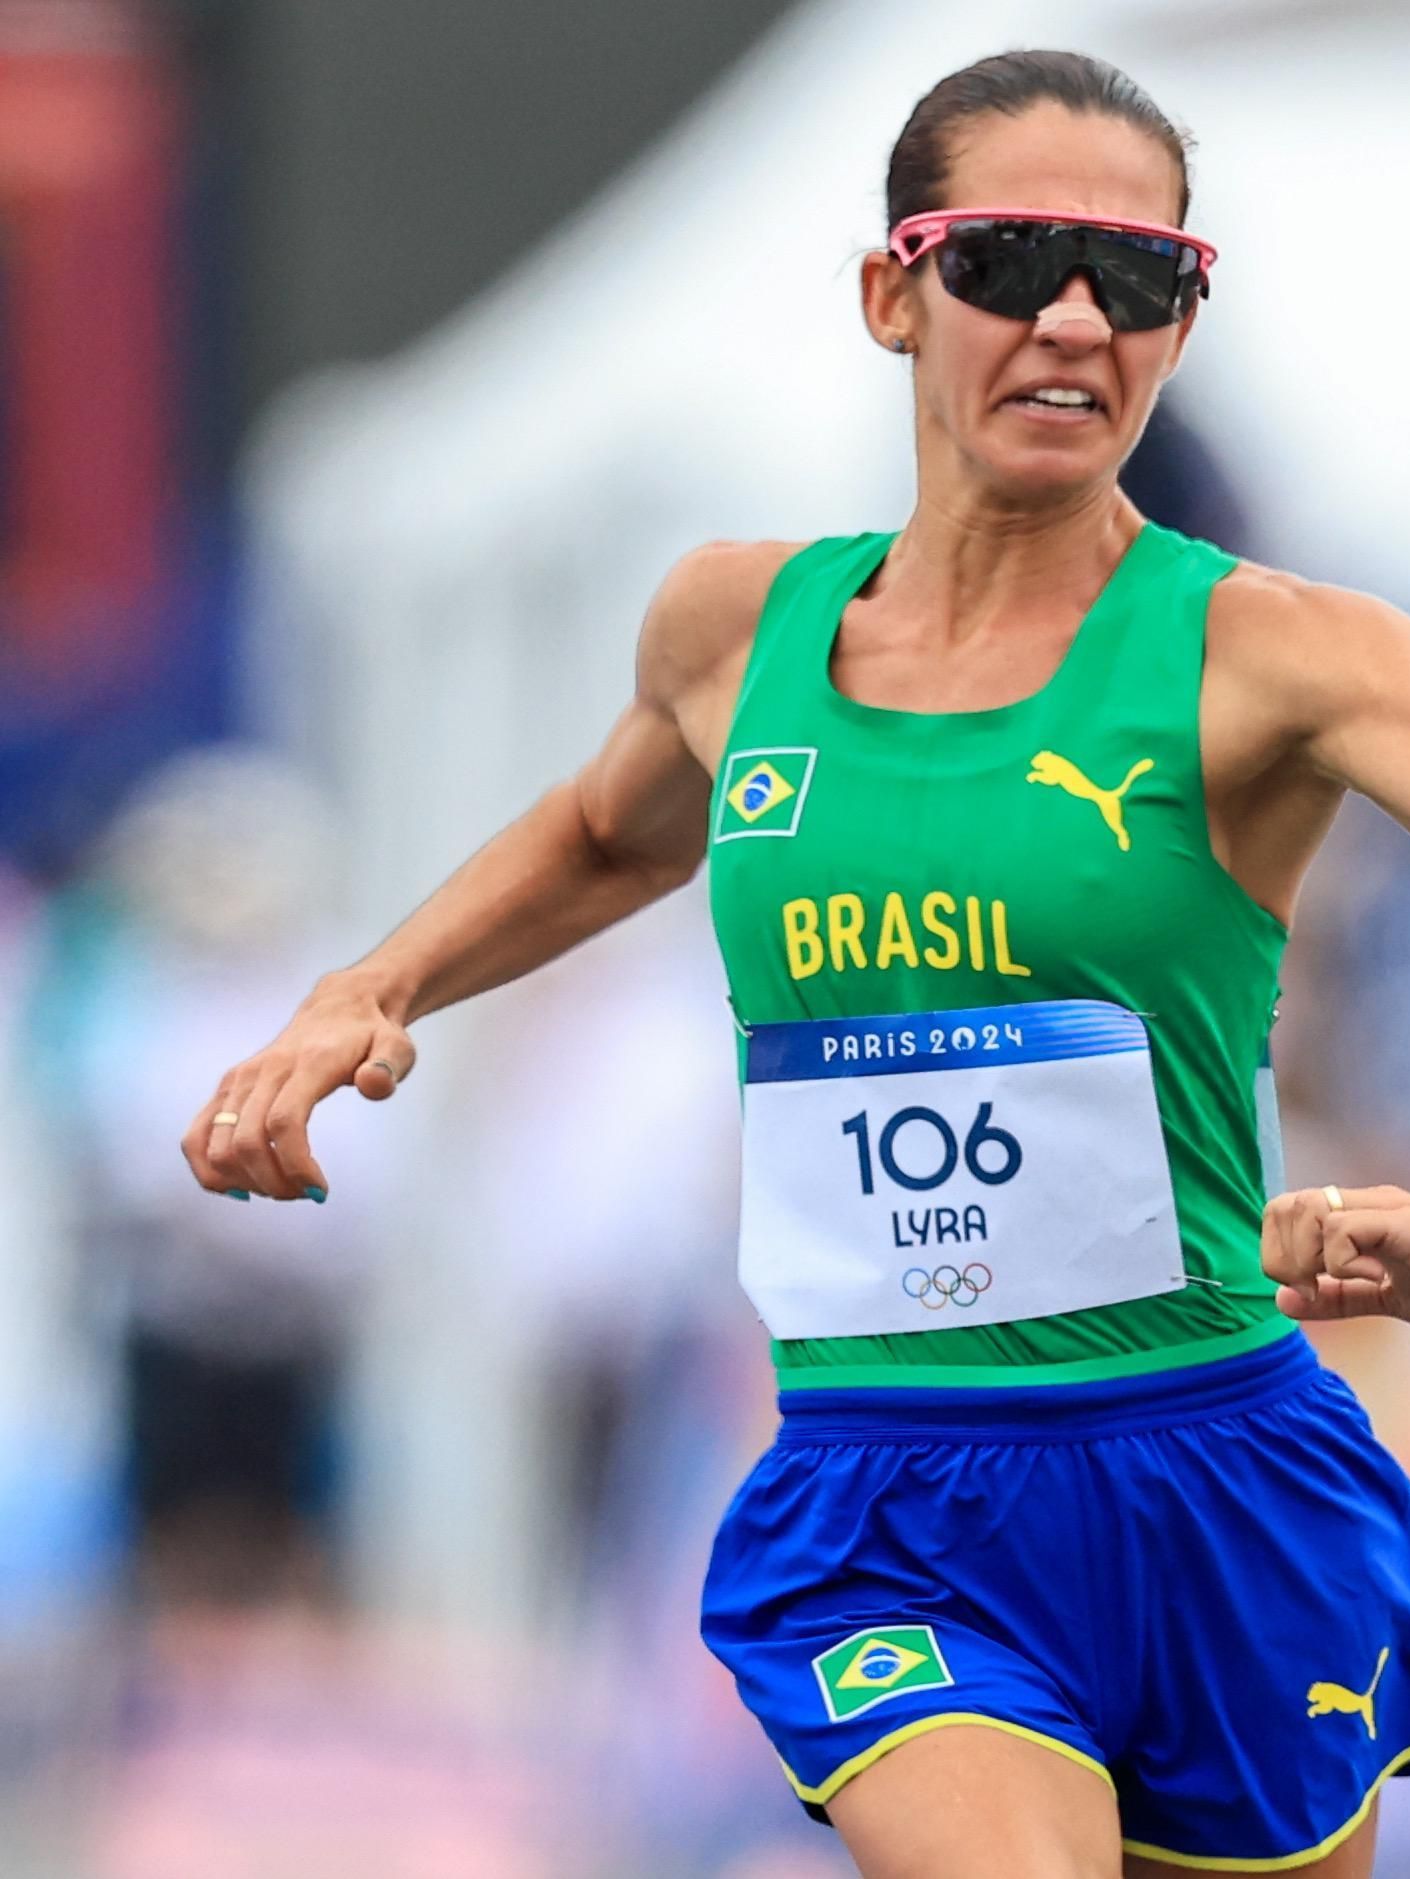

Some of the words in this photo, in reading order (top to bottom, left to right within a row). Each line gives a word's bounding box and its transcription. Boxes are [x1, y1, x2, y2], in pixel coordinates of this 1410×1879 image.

[783, 891, 1031, 980] BRASIL
[928, 1023, 1023, 1055] 2024
[842, 1101, 1023, 1195] 106
[892, 1204, 988, 1248] LYRA
